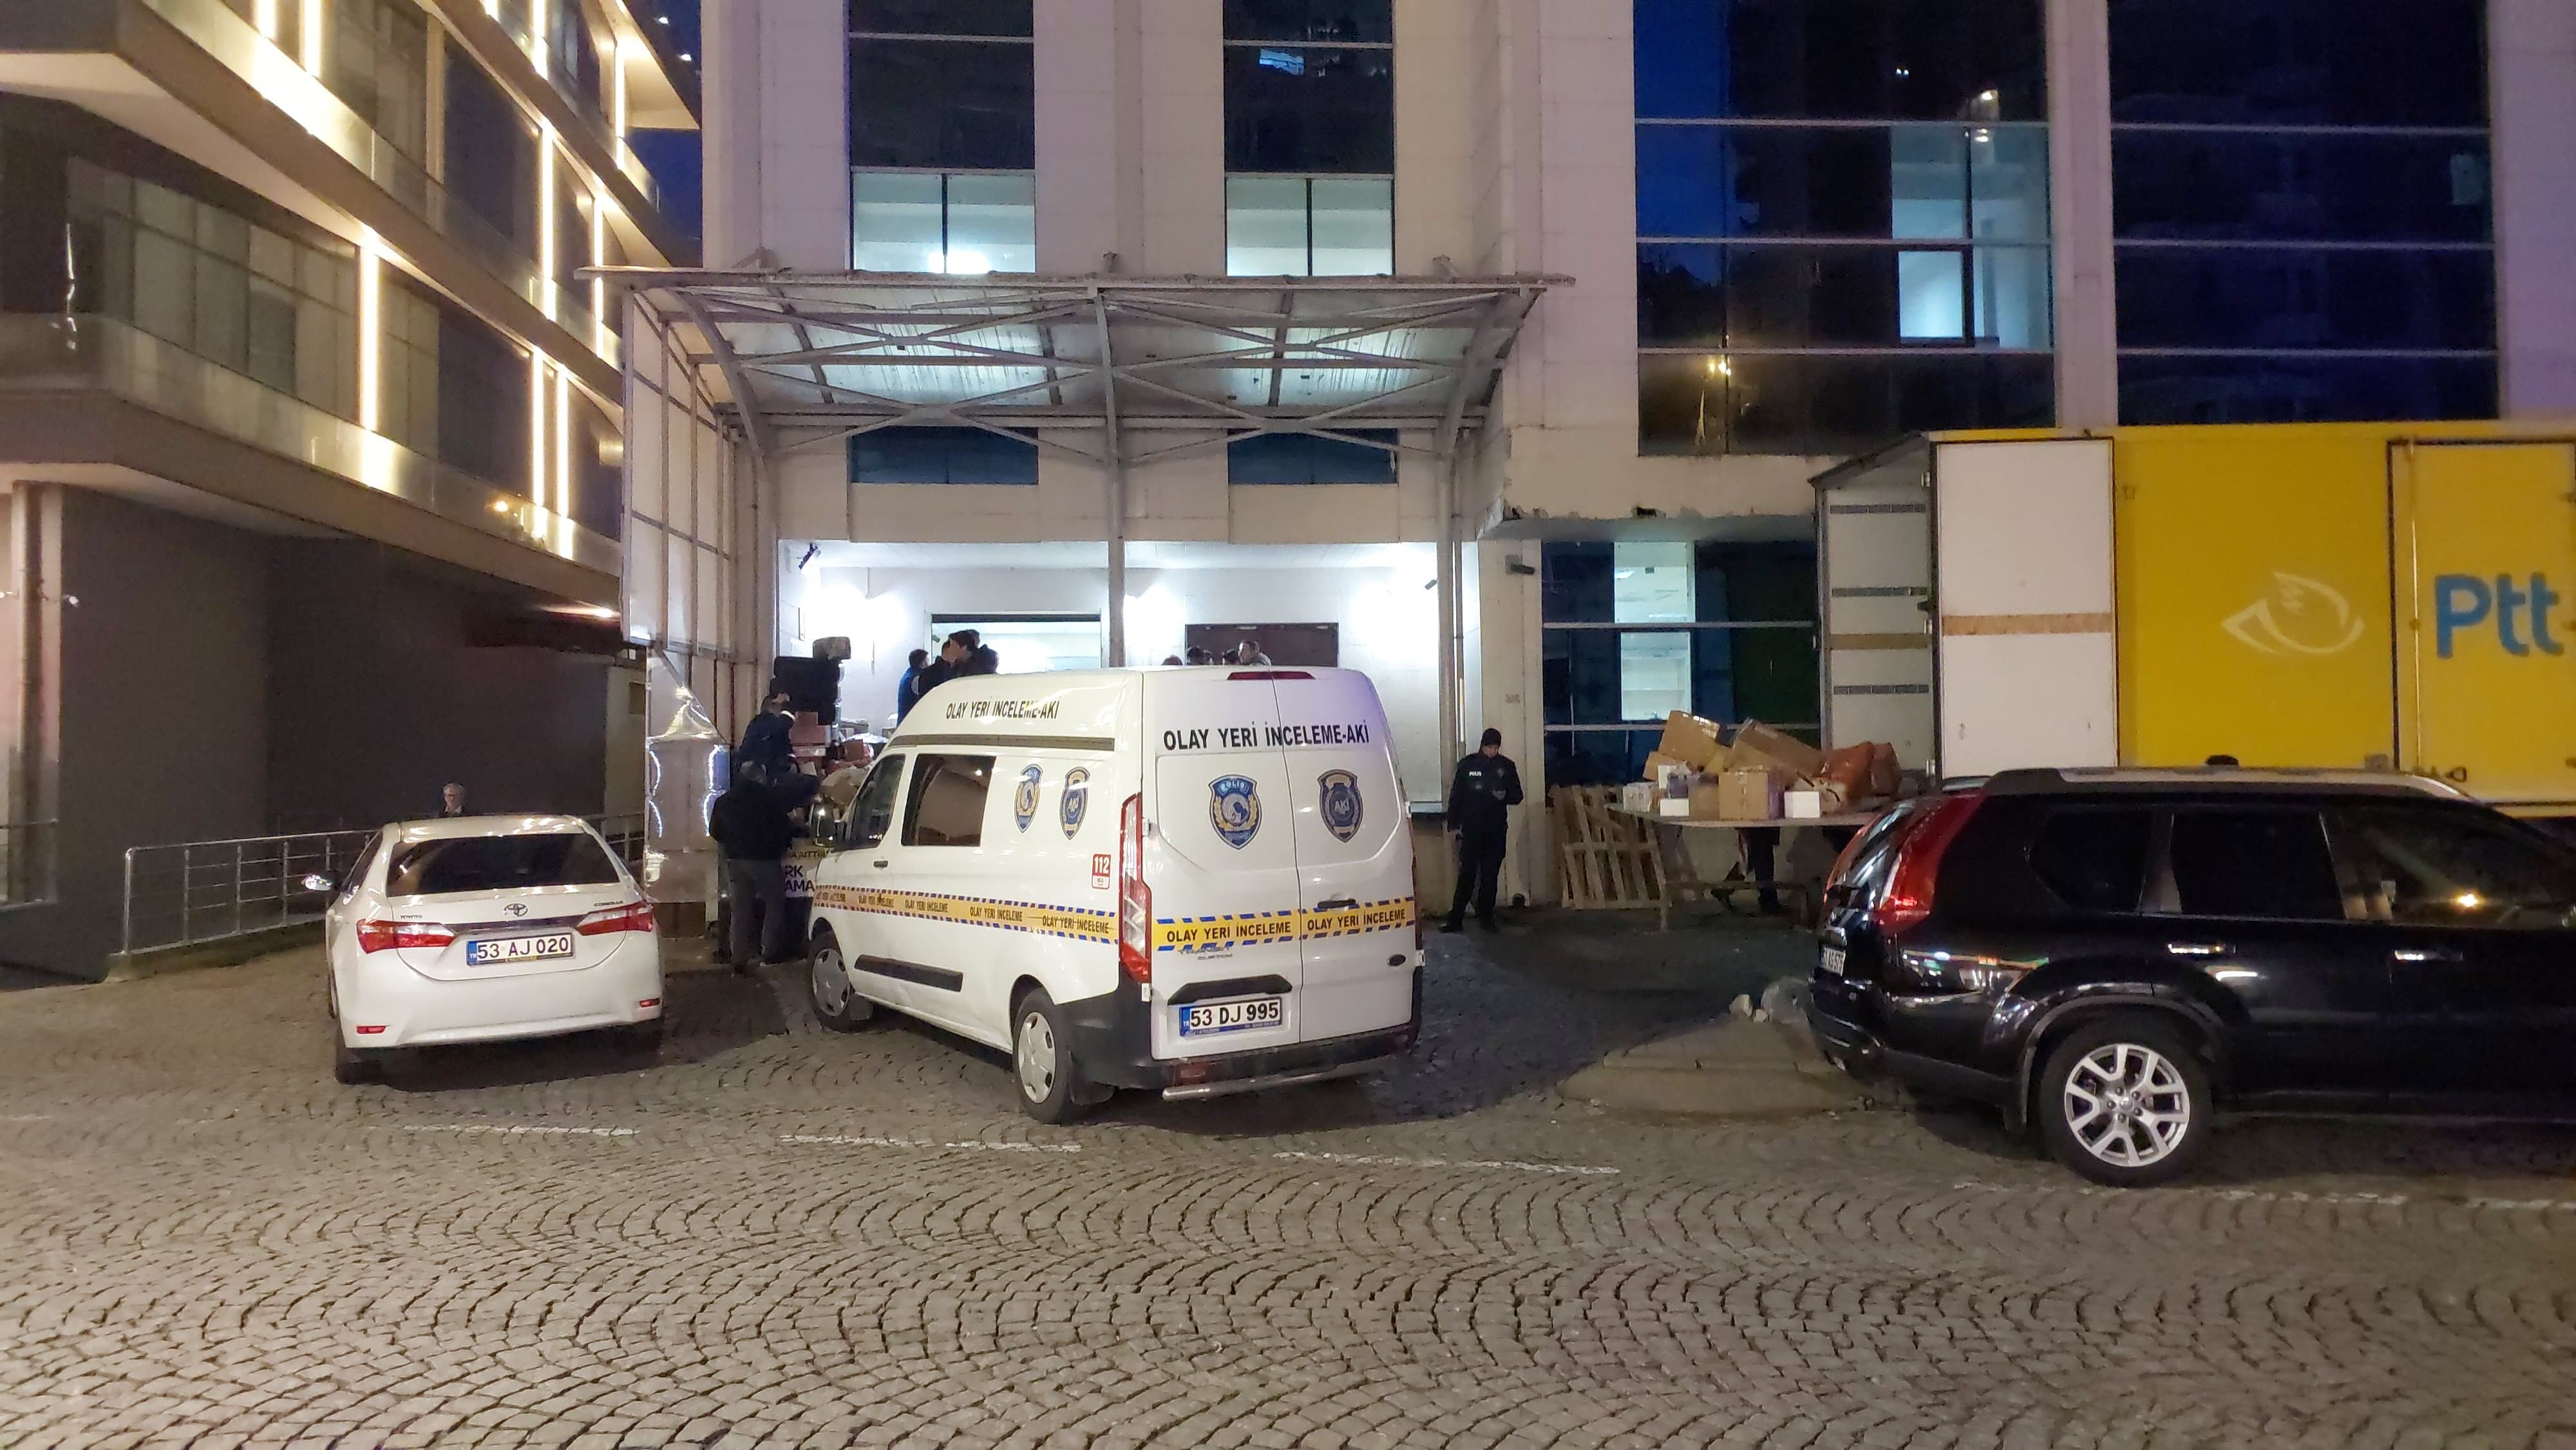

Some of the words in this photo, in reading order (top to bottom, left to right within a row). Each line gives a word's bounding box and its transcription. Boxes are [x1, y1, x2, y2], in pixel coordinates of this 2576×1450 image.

[2435, 572, 2564, 659] Ptt
[946, 702, 968, 719] OLAY
[1164, 729, 1209, 751] OLAY
[1218, 721, 1258, 748] YERİ
[784, 865, 803, 878] RK
[1094, 856, 1110, 874] 112
[785, 880, 815, 892] AMA
[970, 907, 982, 918] OLAY
[1042, 915, 1057, 928] OLAY
[1307, 918, 1332, 931] OLAY
[1167, 928, 1198, 943] OLAY
[478, 943, 499, 959] 53
[509, 940, 530, 957] AJ
[536, 937, 569, 954] 020
[1191, 1009, 1212, 1027] 53
[1220, 1006, 1241, 1025] DJ
[1246, 1002, 1278, 1021] 995
